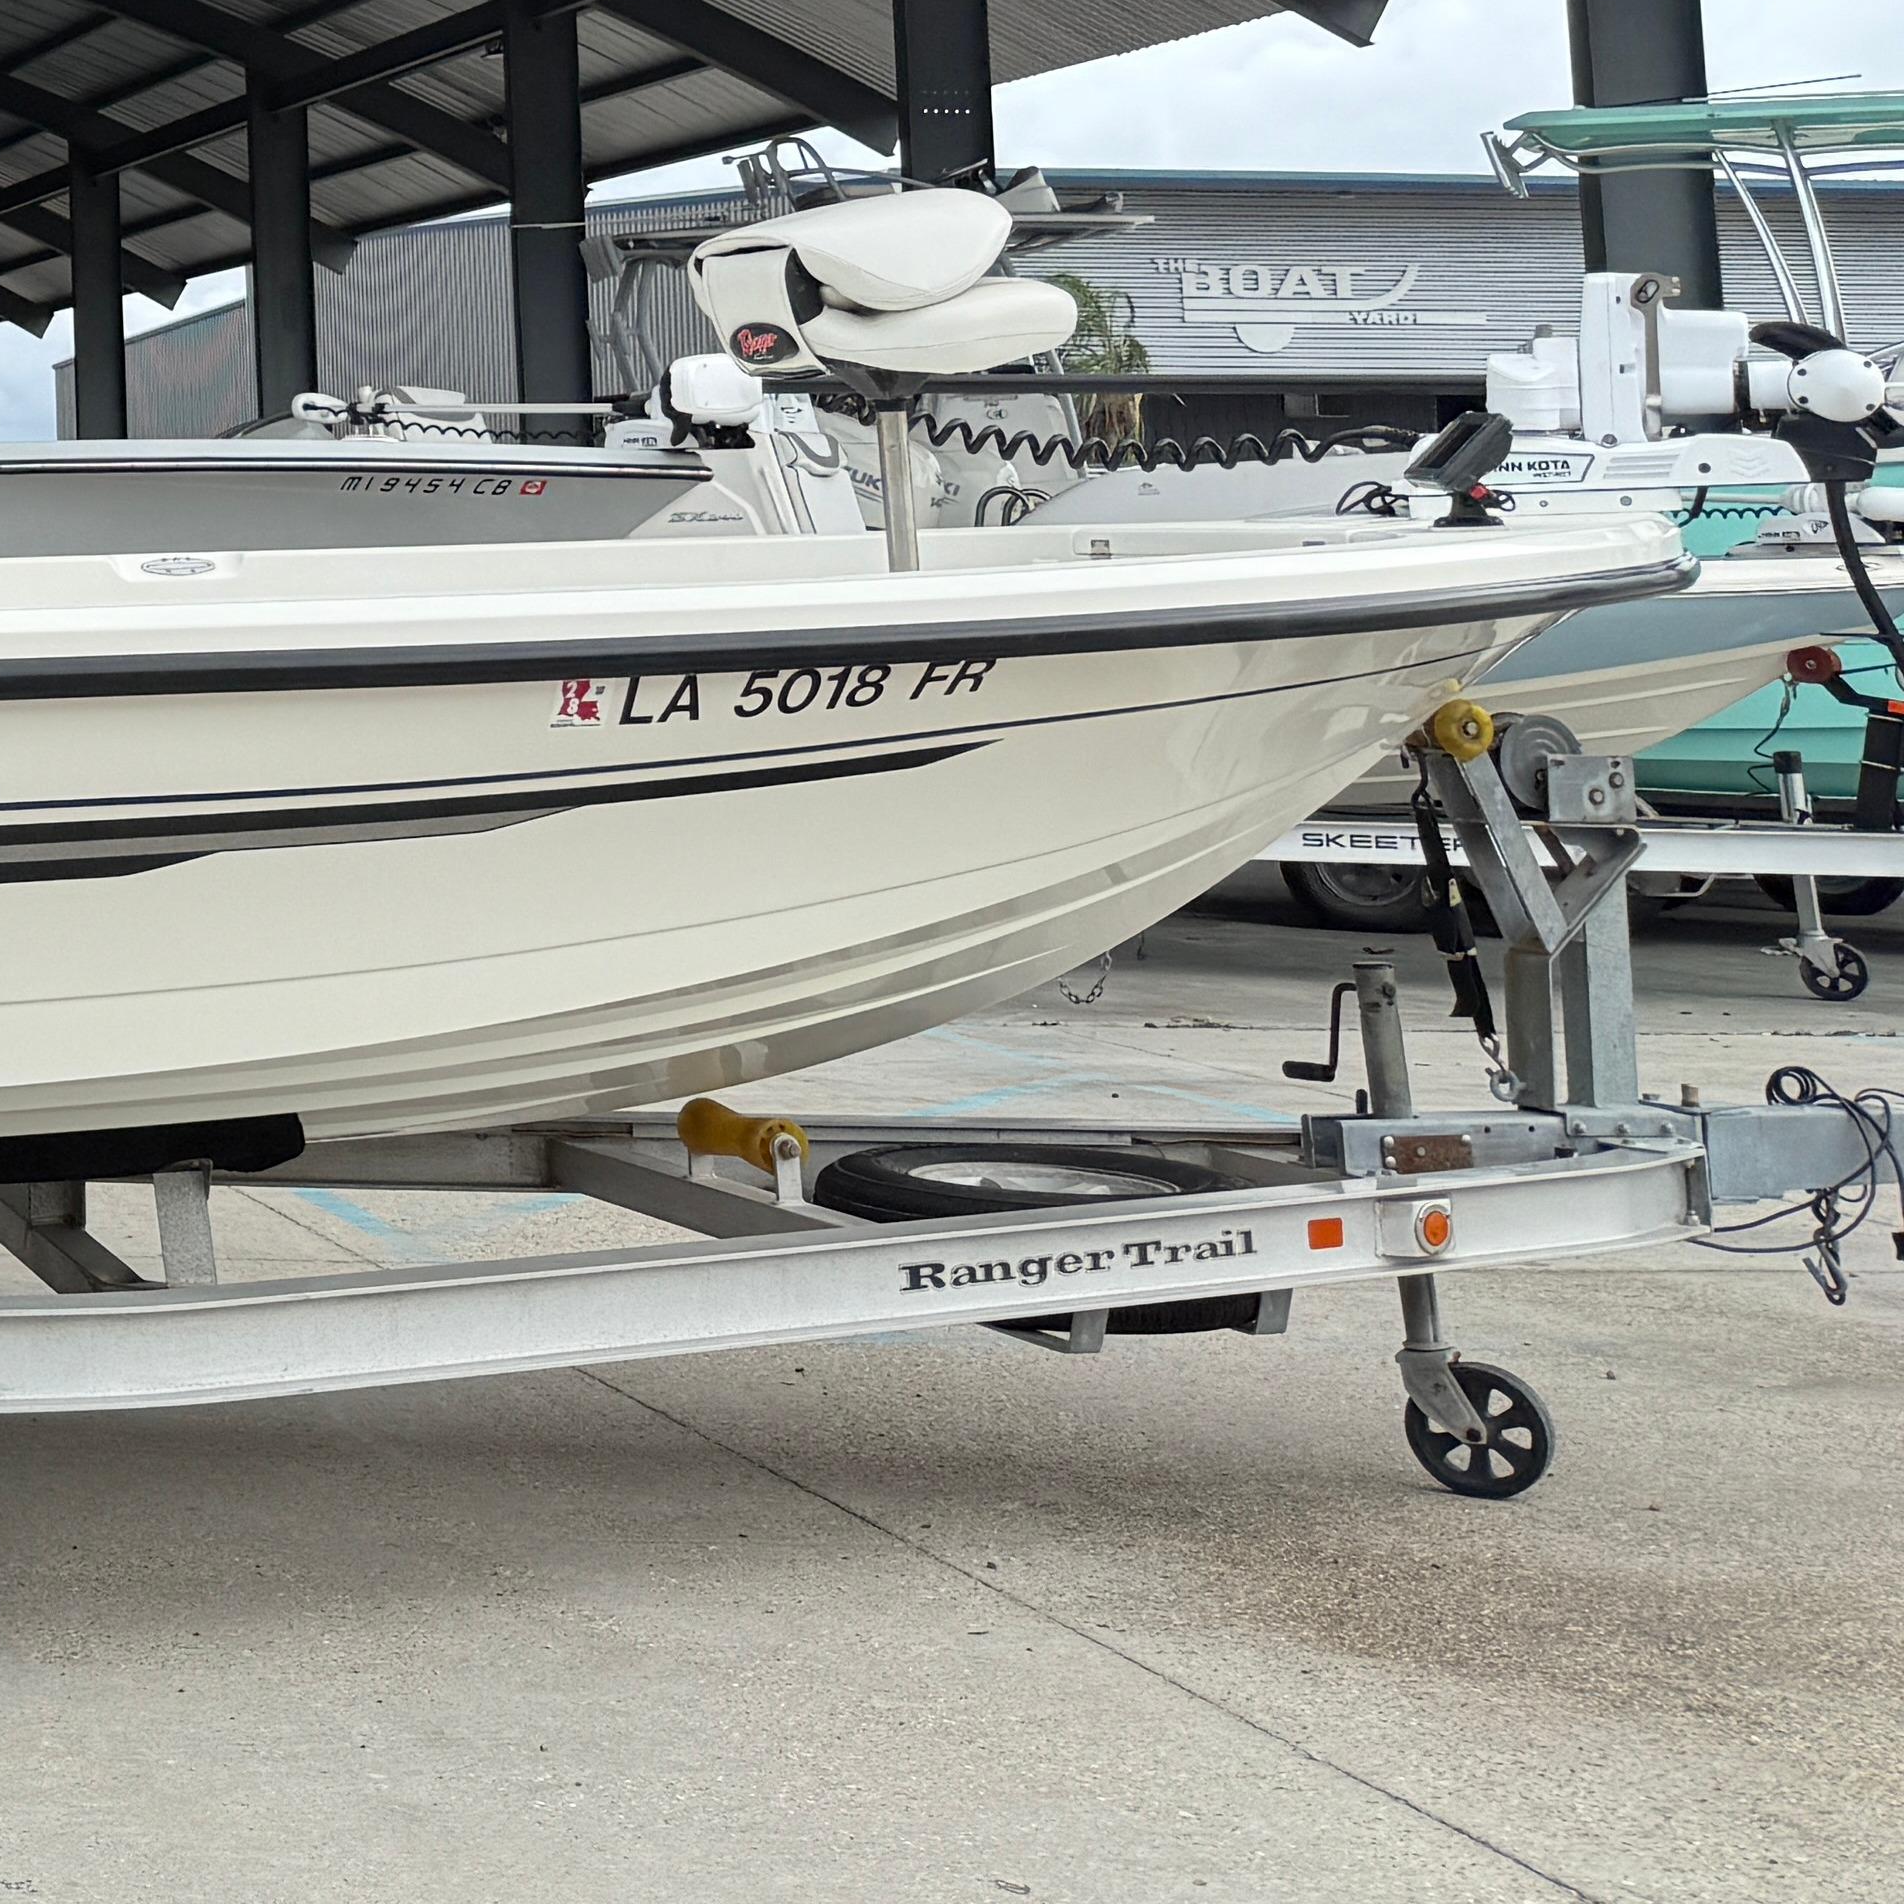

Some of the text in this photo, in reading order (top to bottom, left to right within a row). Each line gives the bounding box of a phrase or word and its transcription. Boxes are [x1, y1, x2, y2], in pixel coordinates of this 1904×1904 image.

[1154, 258, 1200, 274] THE
[1181, 264, 1366, 298] BOAT
[1349, 311, 1418, 326] YARD
[1527, 459, 1571, 472] KOTA
[341, 476, 513, 496] MI 9454 CB
[619, 659, 997, 726] LA 5018 FR
